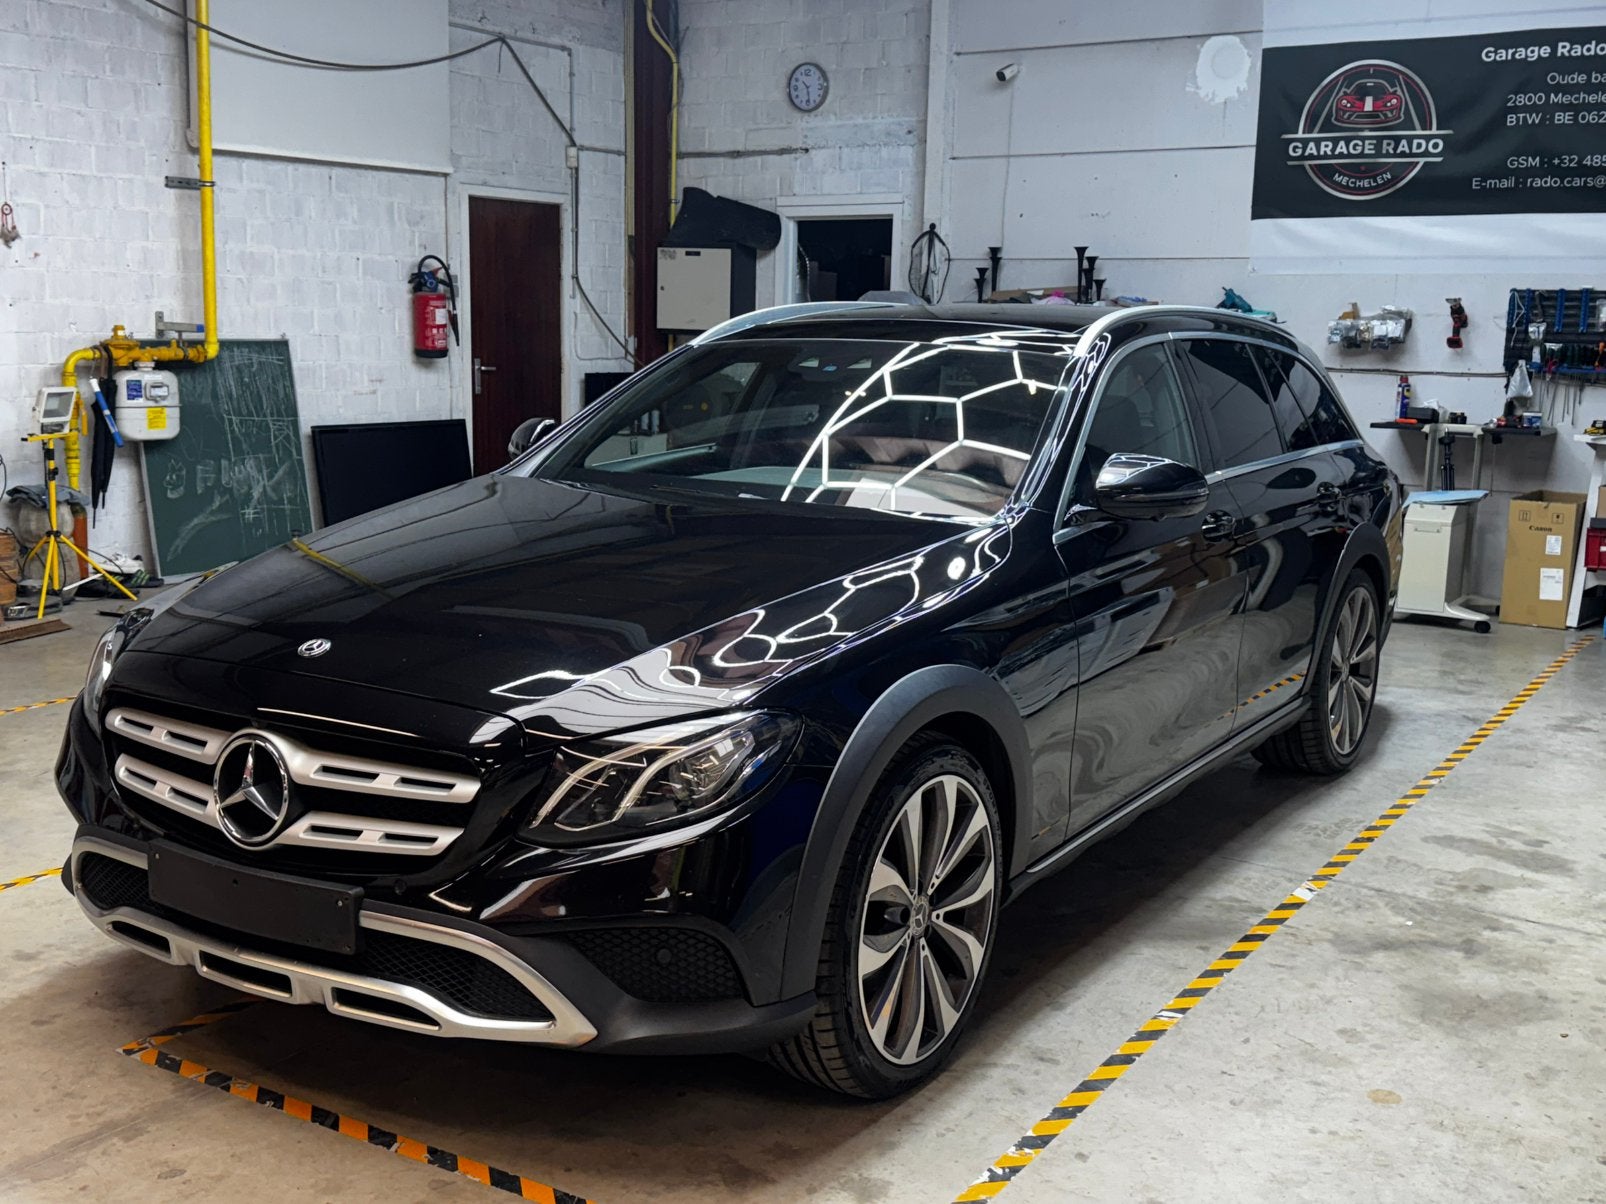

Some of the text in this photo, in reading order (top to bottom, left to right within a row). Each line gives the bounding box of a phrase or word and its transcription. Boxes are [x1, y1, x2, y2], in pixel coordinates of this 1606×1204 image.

[1481, 40, 1606, 62] Garage Rado
[1547, 72, 1587, 85] Oude
[1506, 91, 1606, 107] 2800 Mechele
[1506, 112, 1542, 126] BTW
[1554, 112, 1574, 124] BE
[1578, 111, 1606, 124] 062
[1288, 138, 1444, 157] GARAGE RADO
[1507, 156, 1540, 168] GSM
[1552, 155, 1578, 167] +32
[1582, 154, 1606, 167] 485
[1333, 172, 1392, 188] MECHELEN
[1472, 176, 1515, 189] E-mail
